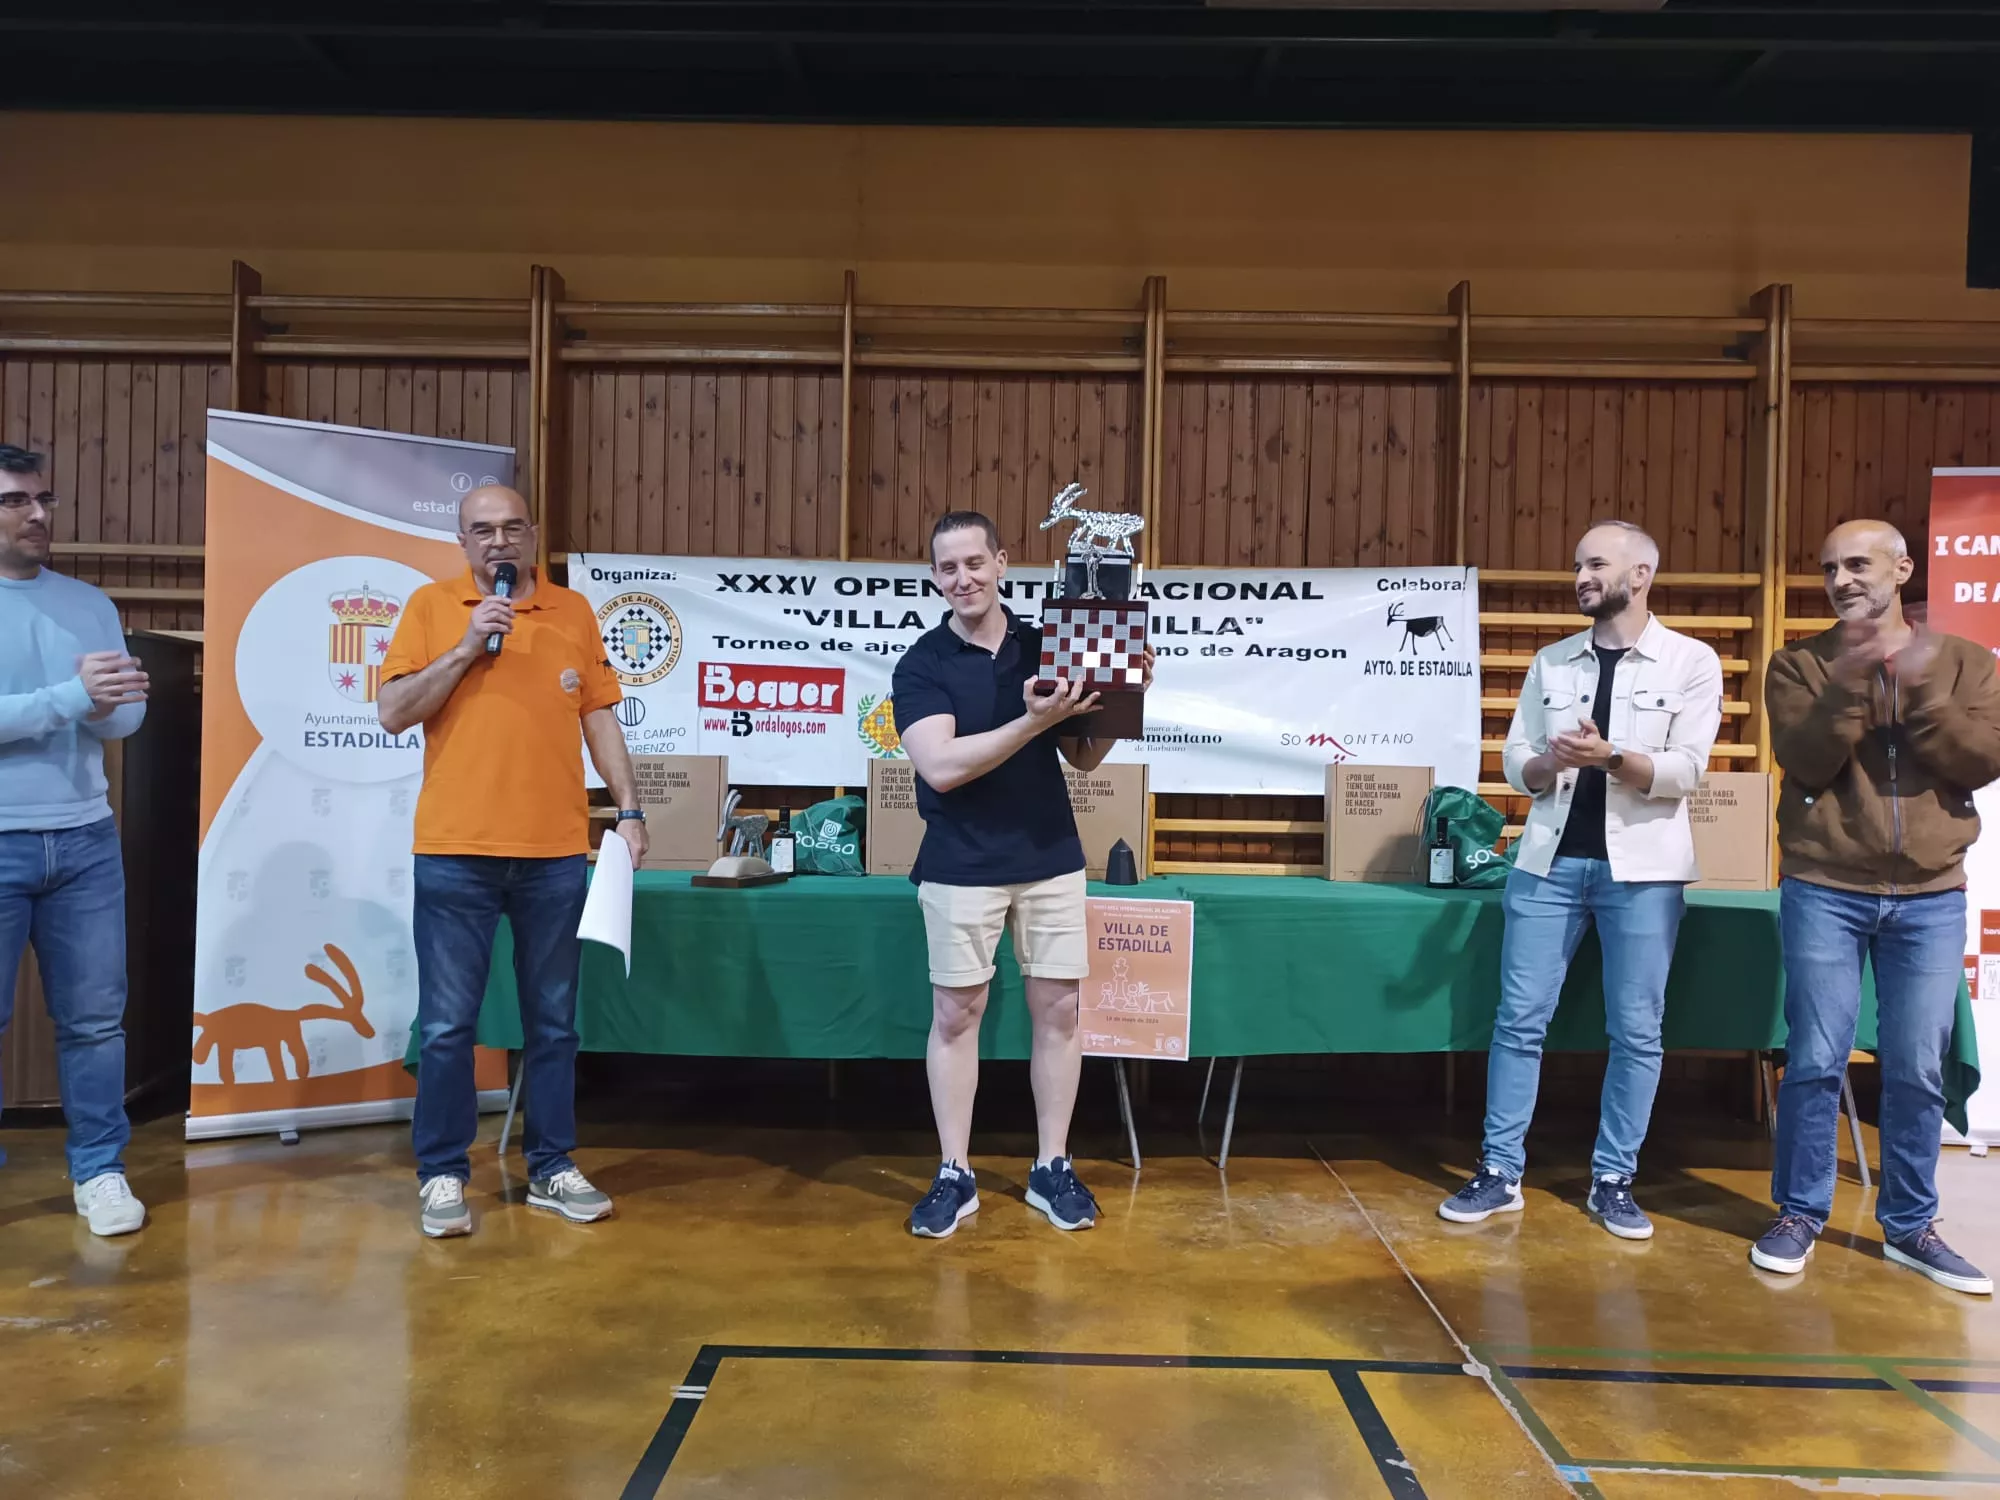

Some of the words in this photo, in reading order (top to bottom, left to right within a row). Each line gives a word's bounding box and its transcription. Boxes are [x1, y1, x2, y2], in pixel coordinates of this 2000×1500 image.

[591, 568, 677, 584] Organiza:
[716, 573, 817, 596] XXXV
[834, 577, 945, 597] OPEN
[1377, 578, 1466, 592] Colabora:
[1954, 582, 1987, 603] DE
[599, 601, 619, 620] CLUB
[621, 595, 634, 604] DE
[636, 595, 673, 622] AJEDREZ
[783, 608, 926, 630] "VILLA
[712, 635, 810, 650] Torneo
[820, 638, 854, 651] de
[651, 636, 680, 679] ESTADILLA
[1200, 643, 1234, 657] de
[1244, 643, 1348, 662] Aragon
[1364, 660, 1397, 676] AYTO.
[1400, 660, 1415, 676] DE
[1418, 661, 1473, 677] ESTADILLA
[304, 731, 420, 749] ESTADILLA
[643, 727, 687, 740] CAMPO
[881, 776, 898, 784] TIENE
[900, 776, 912, 784] QUE
[1346, 782, 1364, 790] TIENE
[1378, 783, 1398, 791] HABER
[881, 793, 889, 801] DE
[890, 793, 910, 801] HACER
[1345, 799, 1353, 807] DE
[1354, 799, 1375, 807] HACER
[1345, 808, 1357, 816] LAS
[1104, 922, 1145, 936] VILLA
[1150, 925, 1169, 937] DE
[1098, 937, 1172, 954] ESTADILLA
